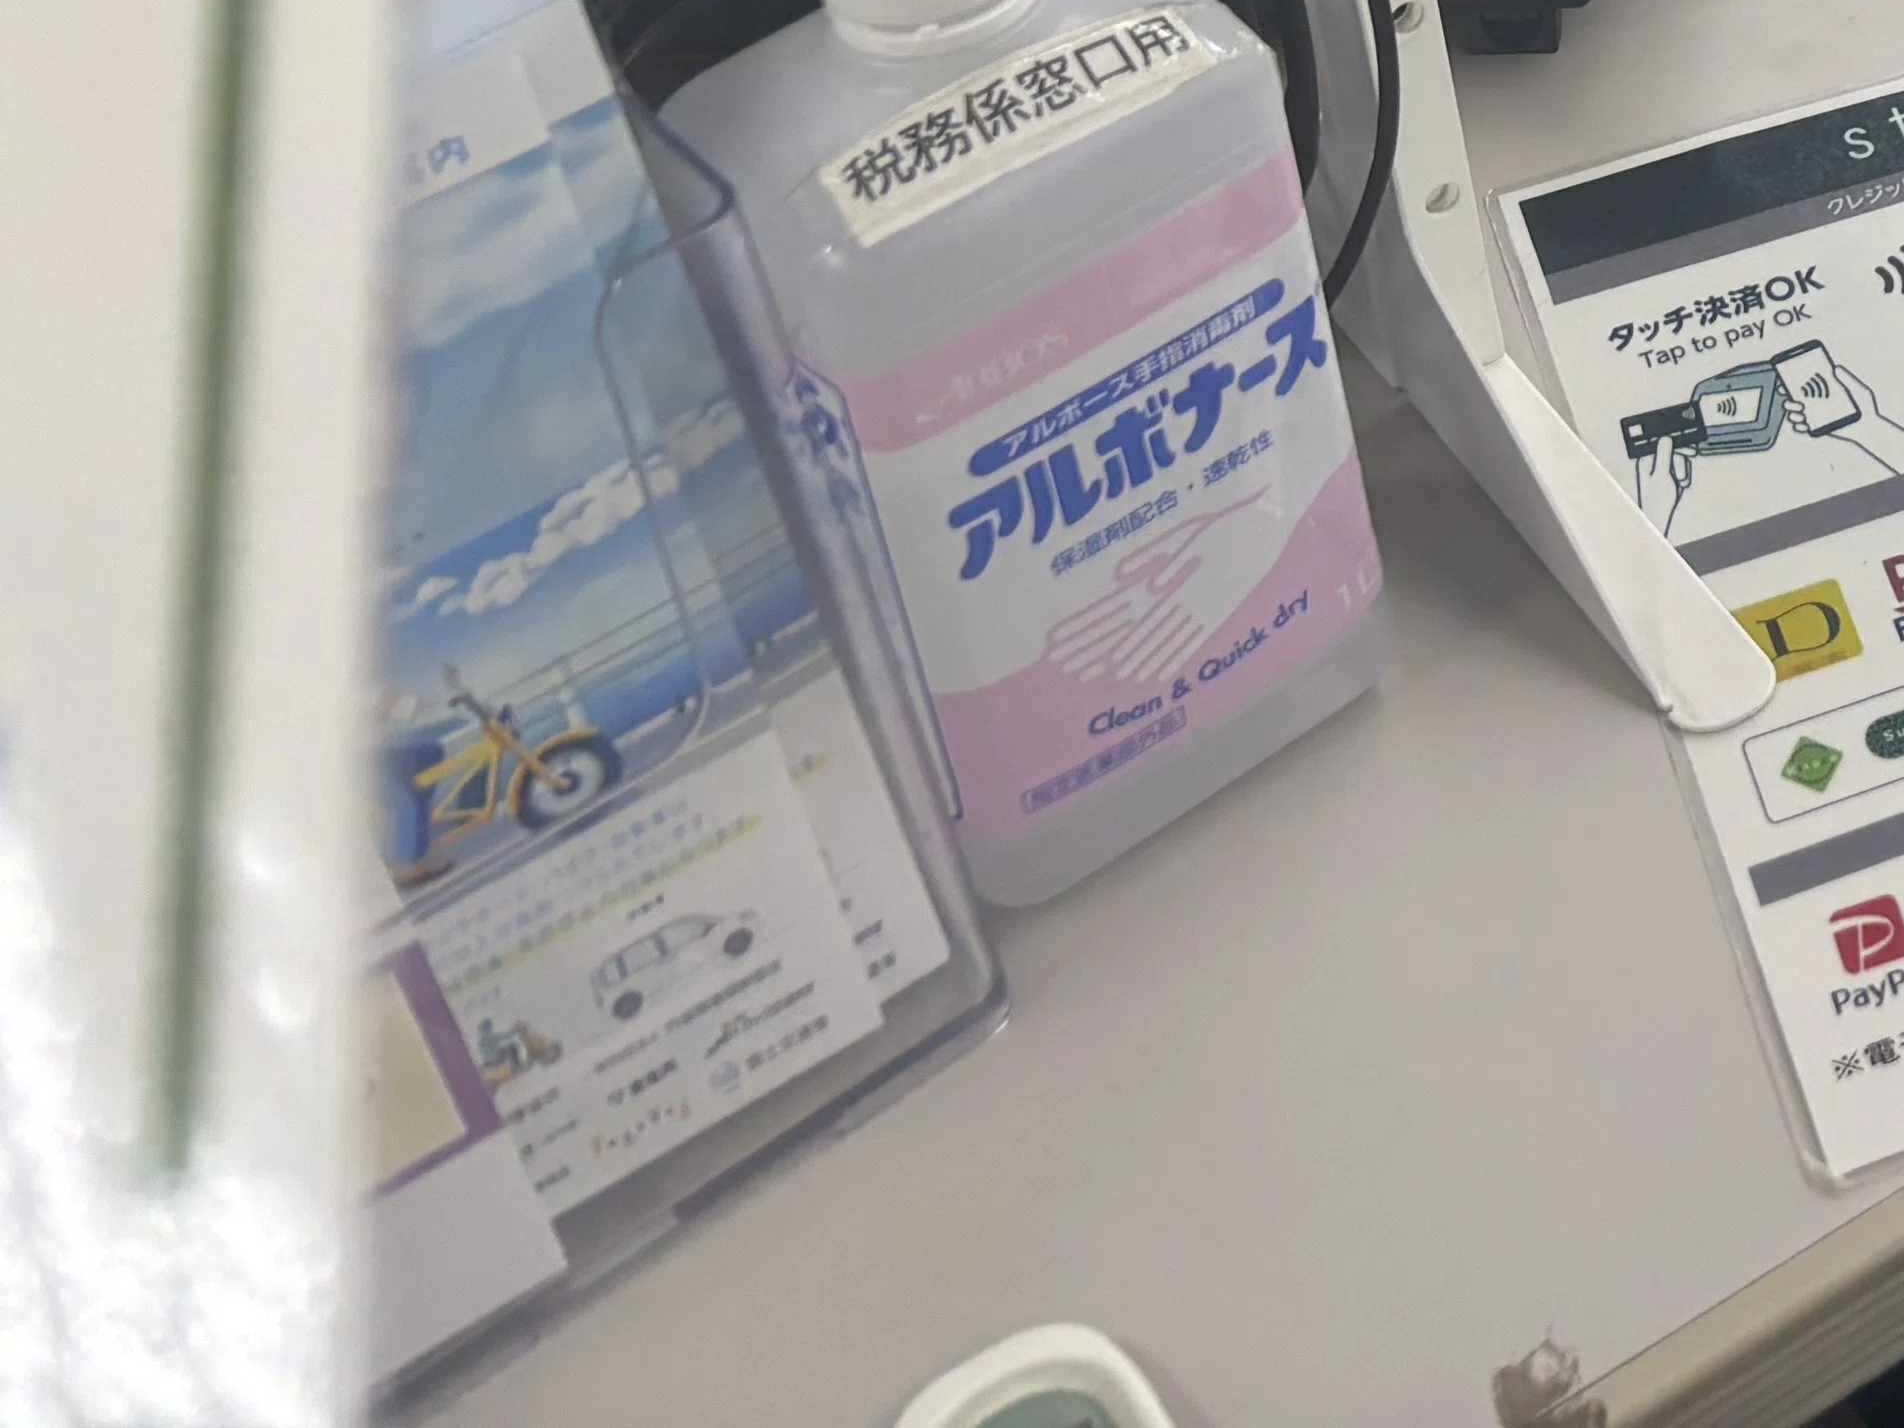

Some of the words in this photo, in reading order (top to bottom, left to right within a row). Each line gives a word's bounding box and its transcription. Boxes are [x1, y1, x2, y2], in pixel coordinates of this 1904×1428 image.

[841, 15, 1195, 205] 税務係窓口用
[1001, 295, 1258, 456] アルボース手指消毒剤
[1606, 264, 1826, 354] タッチ決済OK
[1638, 340, 1686, 374] Tap
[1691, 332, 1719, 355] to
[1723, 320, 1770, 355] pay
[1774, 303, 1813, 332] OK
[940, 292, 1330, 582] アルボナース
[1087, 695, 1163, 739] Clean
[1170, 679, 1192, 702] &
[1198, 626, 1270, 682] Quick
[1272, 589, 1310, 629] dry
